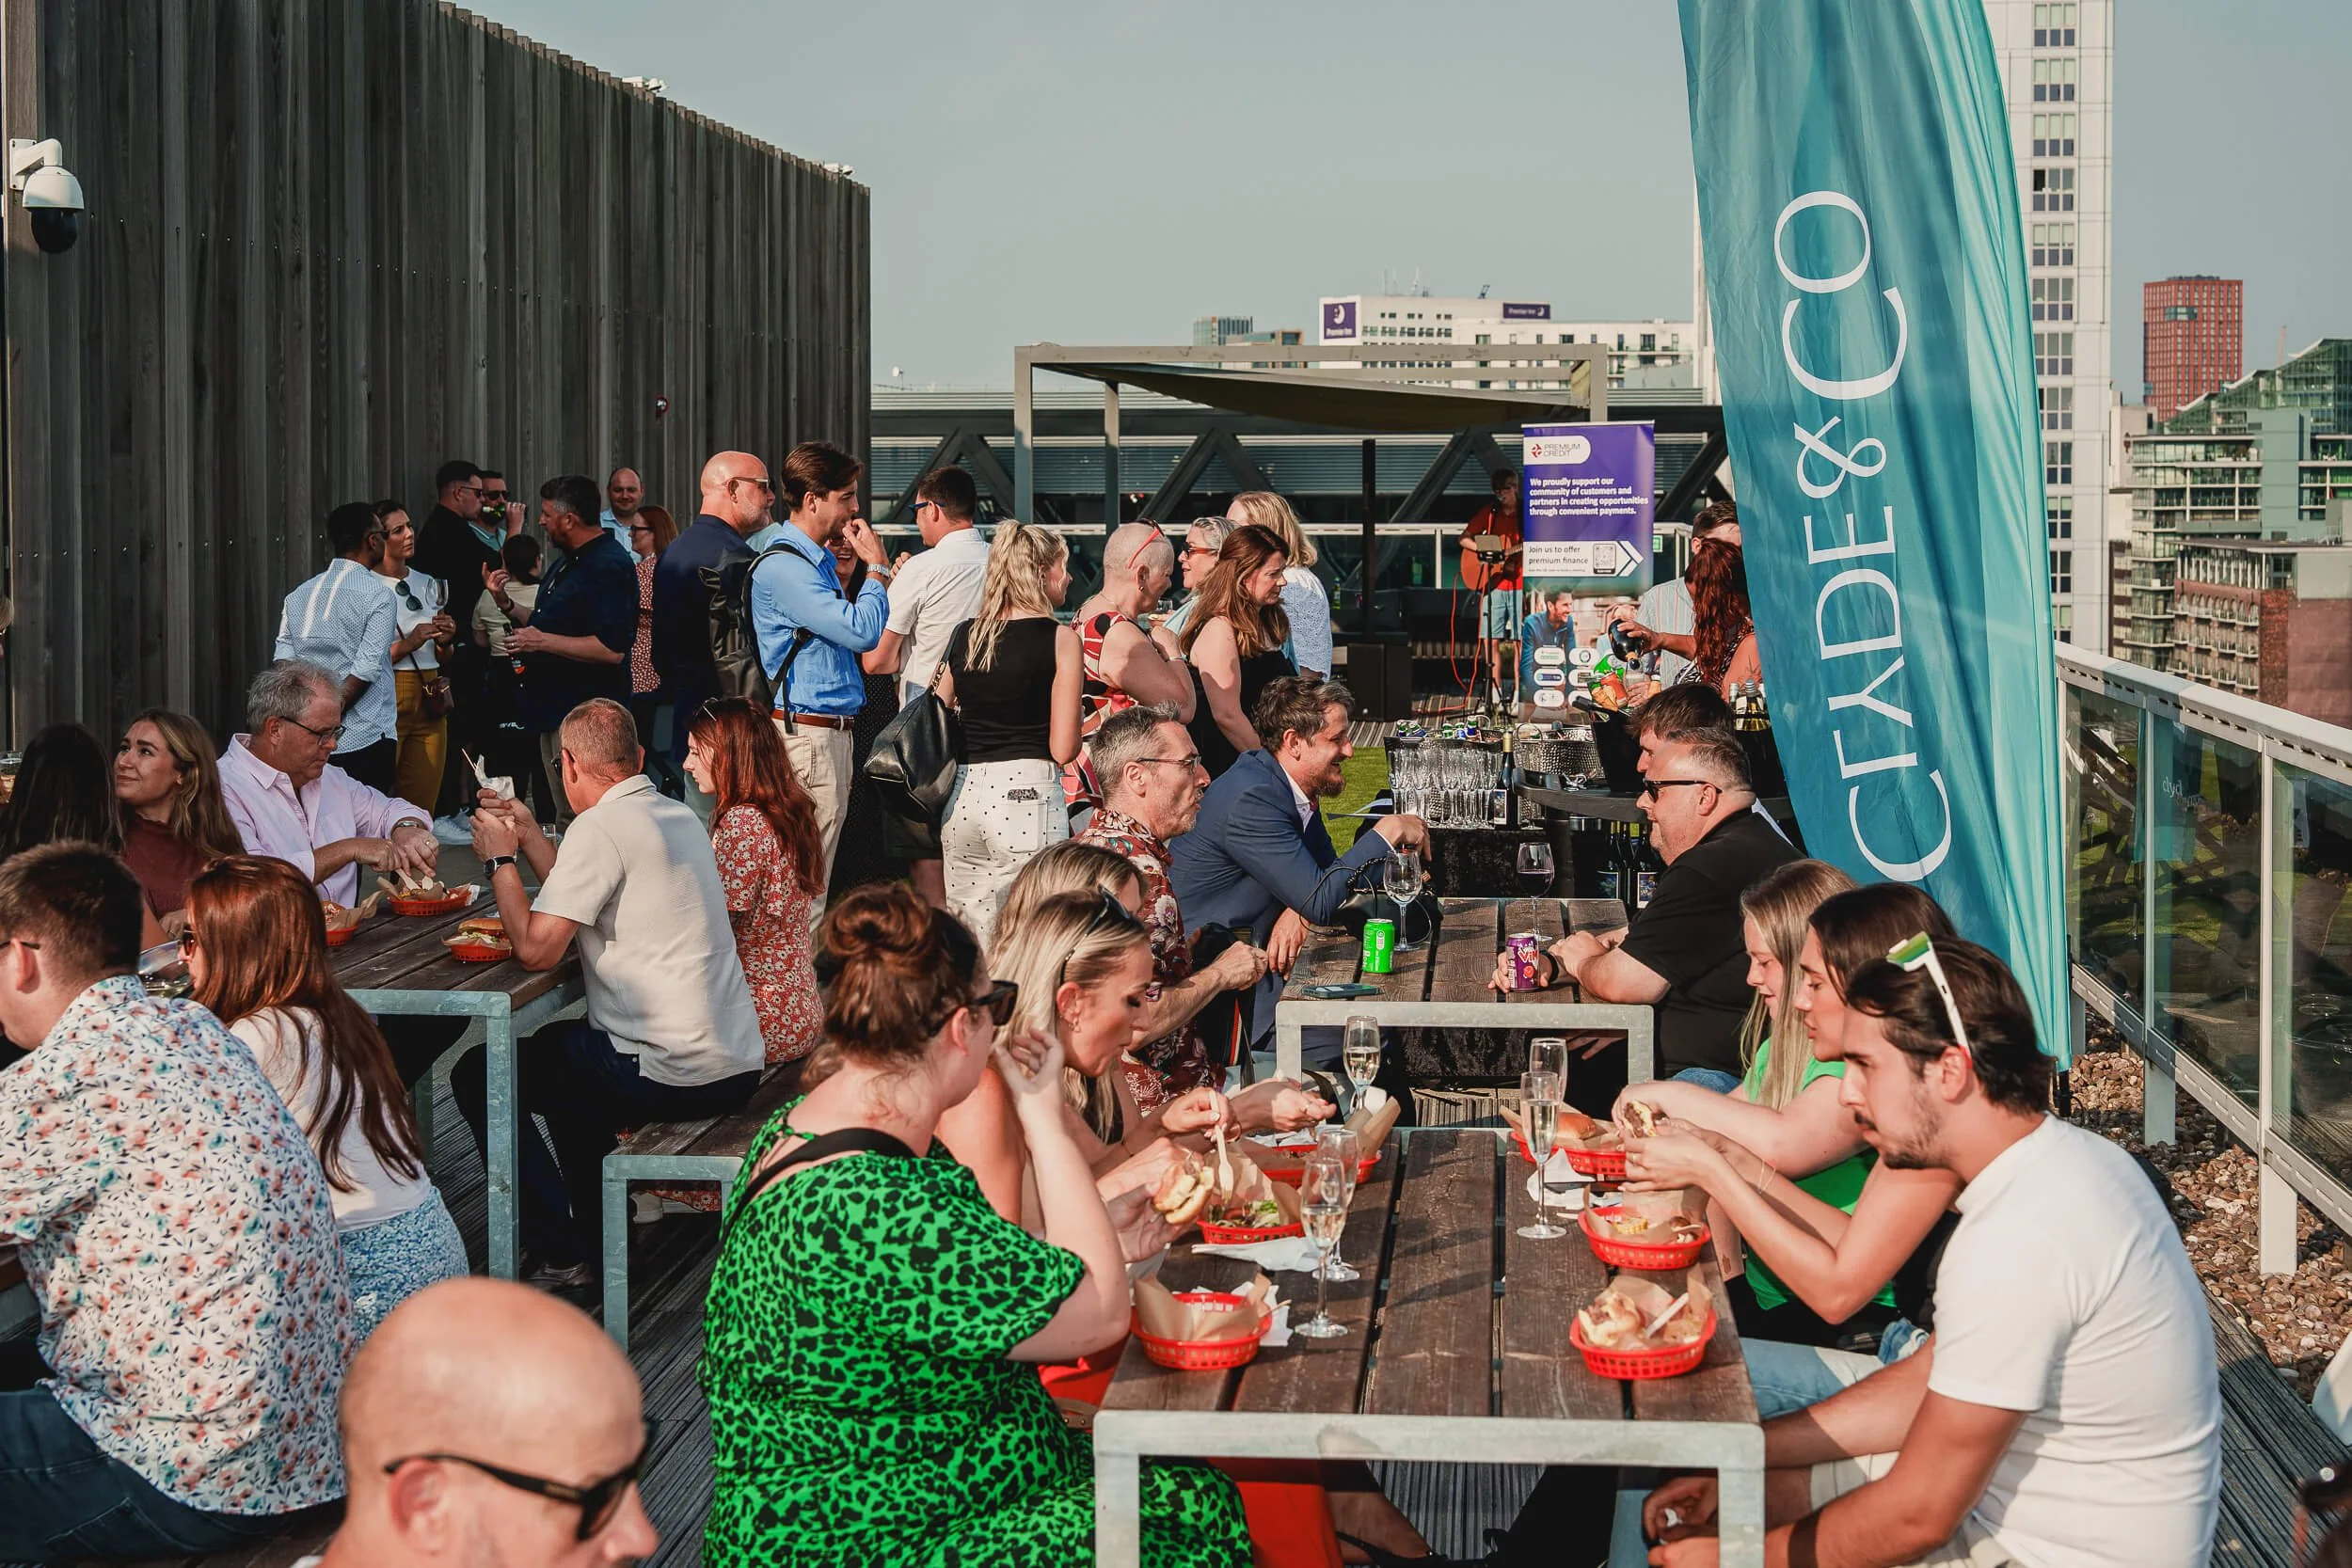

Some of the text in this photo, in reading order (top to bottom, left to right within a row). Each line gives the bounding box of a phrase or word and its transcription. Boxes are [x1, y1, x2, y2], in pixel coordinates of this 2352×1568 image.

[1530, 478, 1542, 486] We
[1542, 477, 1570, 487] proudly
[1572, 477, 1600, 487] support
[1530, 487, 1570, 497] community
[1580, 486, 1617, 495] customers
[1618, 485, 1632, 495] and
[1530, 498, 1560, 507] partners
[1569, 497, 1598, 506] creating
[1599, 496, 1649, 506] opportunities
[1529, 507, 1637, 516] through convenient payments.
[1528, 546, 1543, 554] Join
